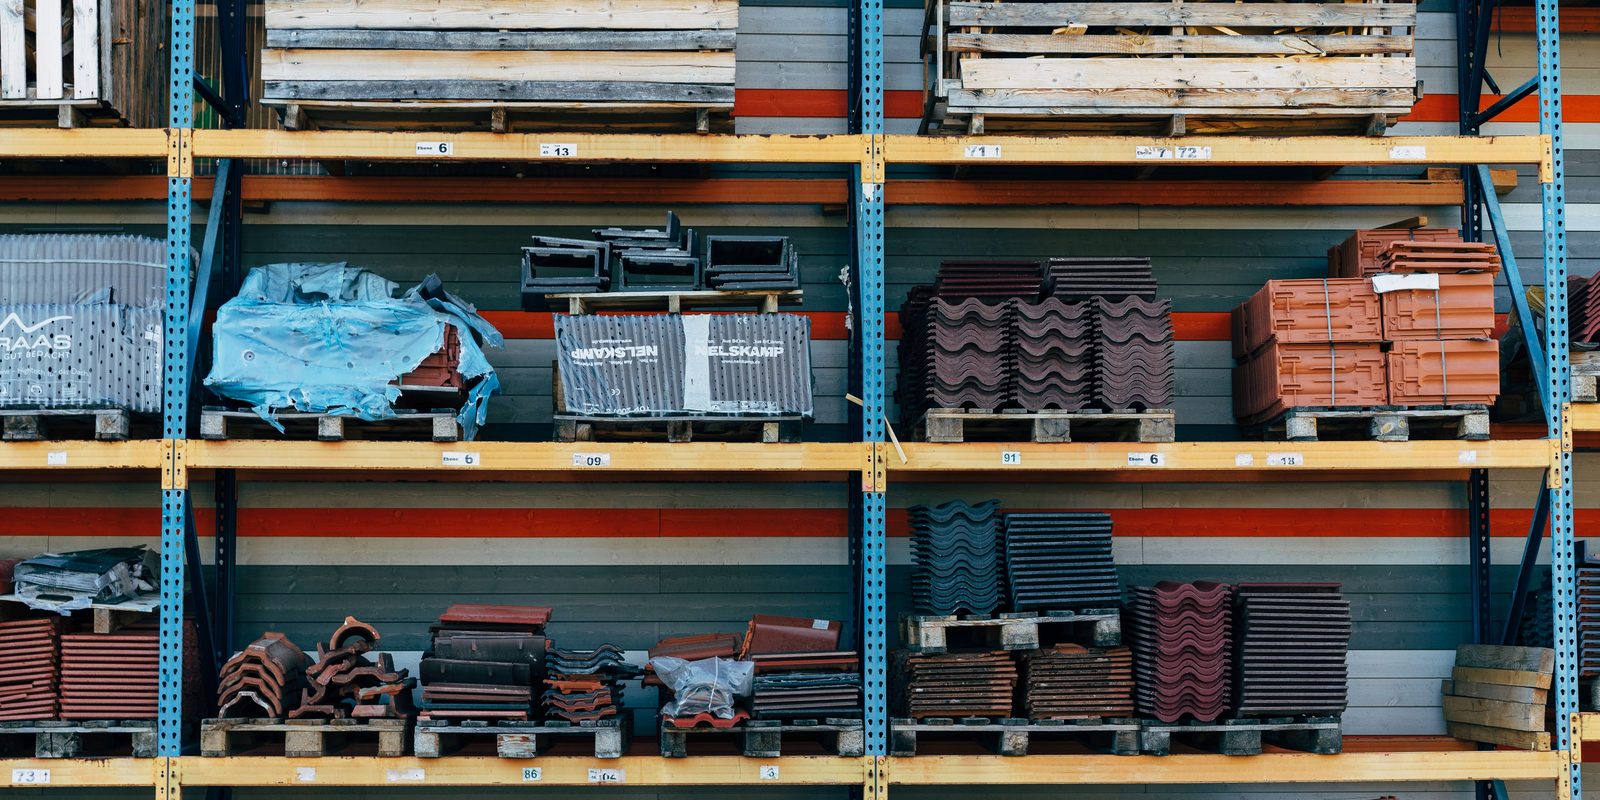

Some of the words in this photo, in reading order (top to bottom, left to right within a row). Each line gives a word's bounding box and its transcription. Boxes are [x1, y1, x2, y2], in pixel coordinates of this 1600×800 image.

[438, 143, 448, 153] 6
[554, 147, 570, 156] 13
[967, 146, 986, 157] 71
[1158, 147, 1168, 158] 7
[1178, 147, 1197, 158] 72
[3, 352, 23, 360] GUT
[571, 345, 659, 360] NELSKAMP
[464, 454, 474, 465] 6
[586, 456, 602, 466] 09
[1003, 453, 1016, 462] 91
[1149, 453, 1159, 465] 6
[16, 770, 35, 782] 73
[524, 769, 538, 779] 86
